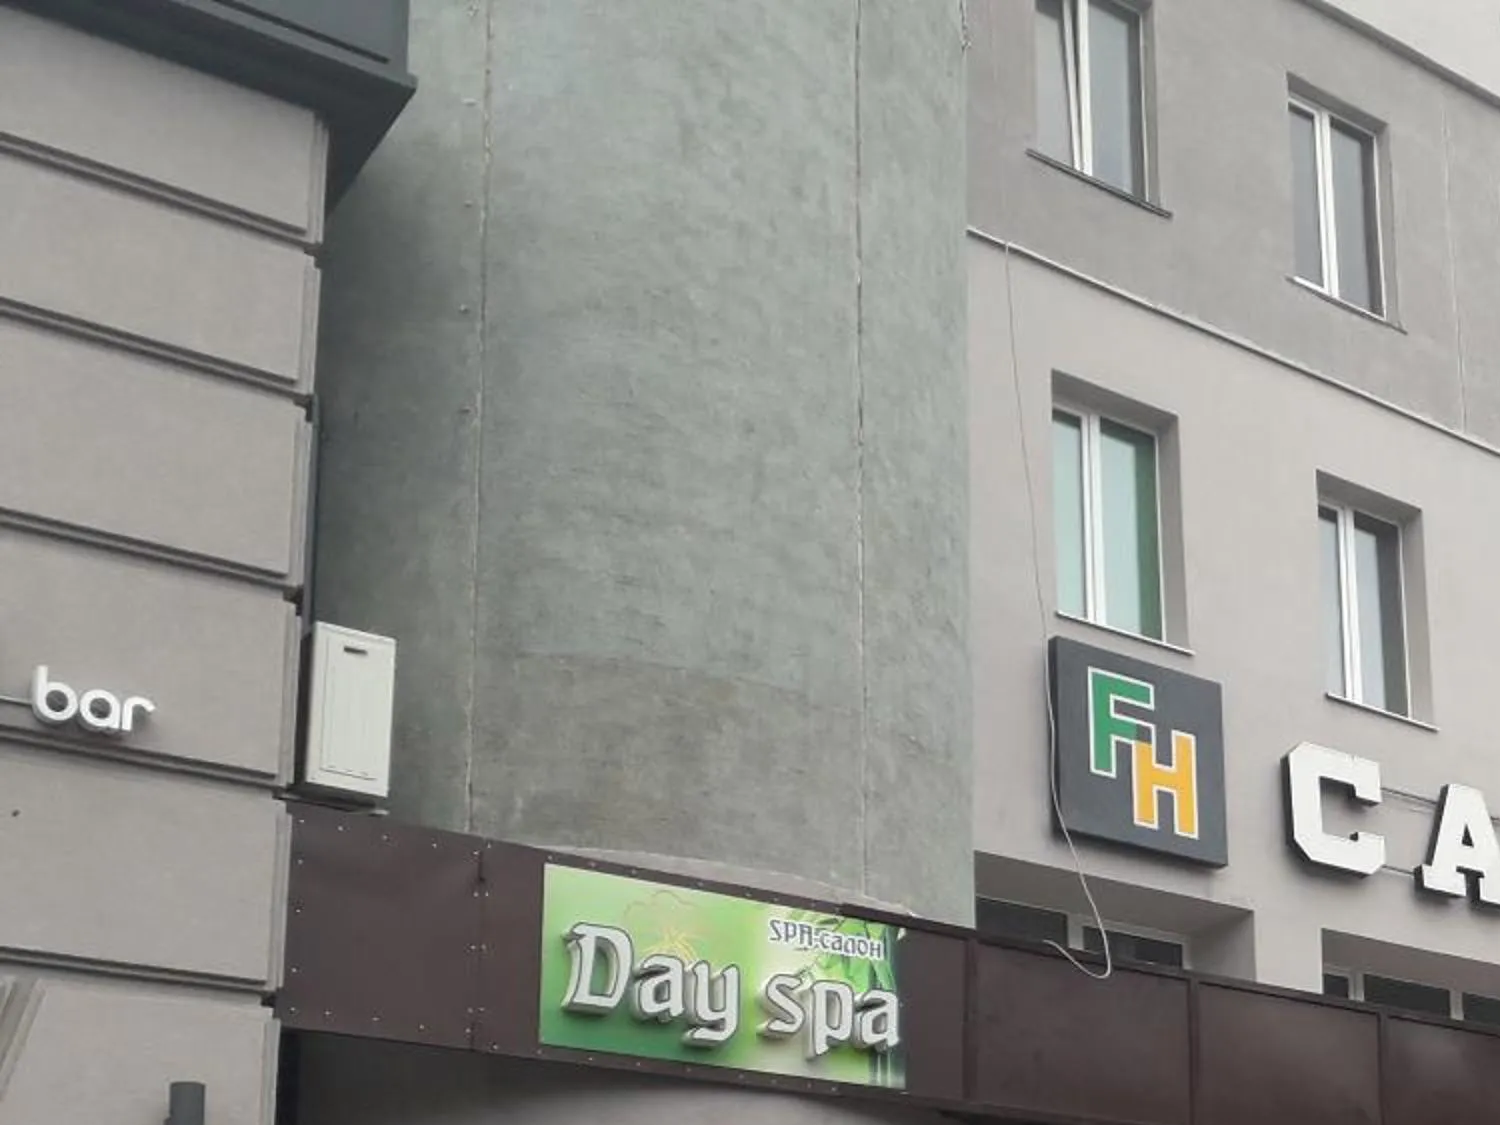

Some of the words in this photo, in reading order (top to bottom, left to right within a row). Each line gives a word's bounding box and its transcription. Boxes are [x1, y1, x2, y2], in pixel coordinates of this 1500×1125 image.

[33, 665, 156, 732] bar
[562, 921, 740, 1048] Day
[755, 970, 902, 1060] spa
